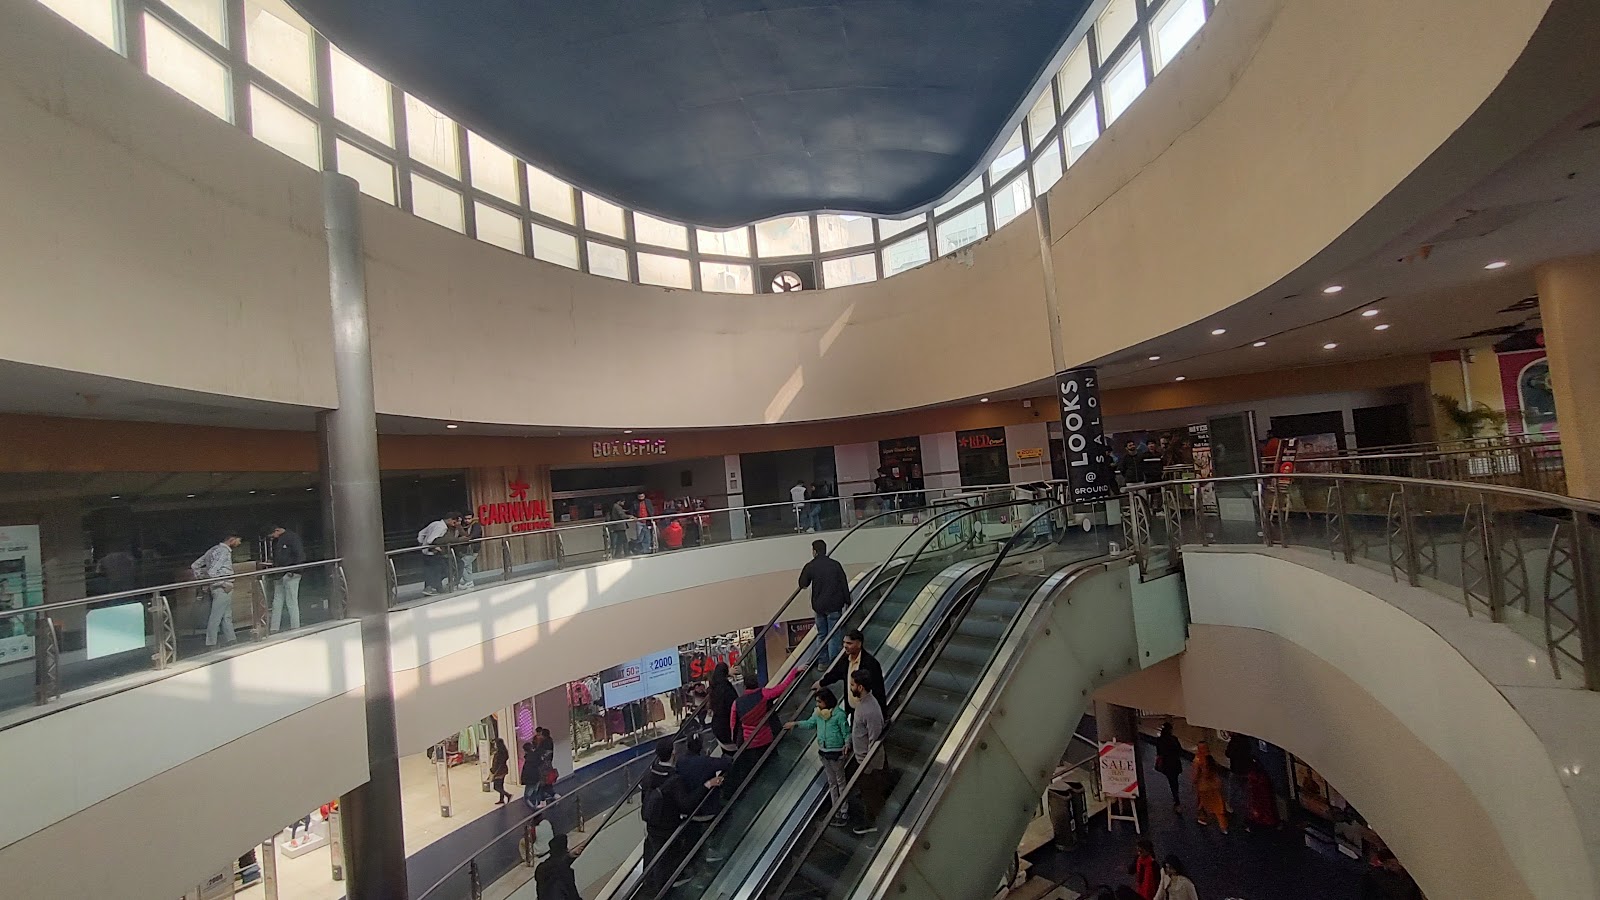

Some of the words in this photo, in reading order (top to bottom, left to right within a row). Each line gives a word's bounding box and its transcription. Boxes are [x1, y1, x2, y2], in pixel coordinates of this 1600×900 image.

[1061, 380, 1089, 467] LOOKS
[1085, 378, 1105, 463] SALON
[593, 440, 620, 457] BOX
[623, 439, 667, 456] OFFICE
[1085, 472, 1097, 483] @
[1074, 484, 1109, 495] GROUND
[478, 500, 551, 527] CARNIVAL
[1101, 759, 1134, 772] SALE
